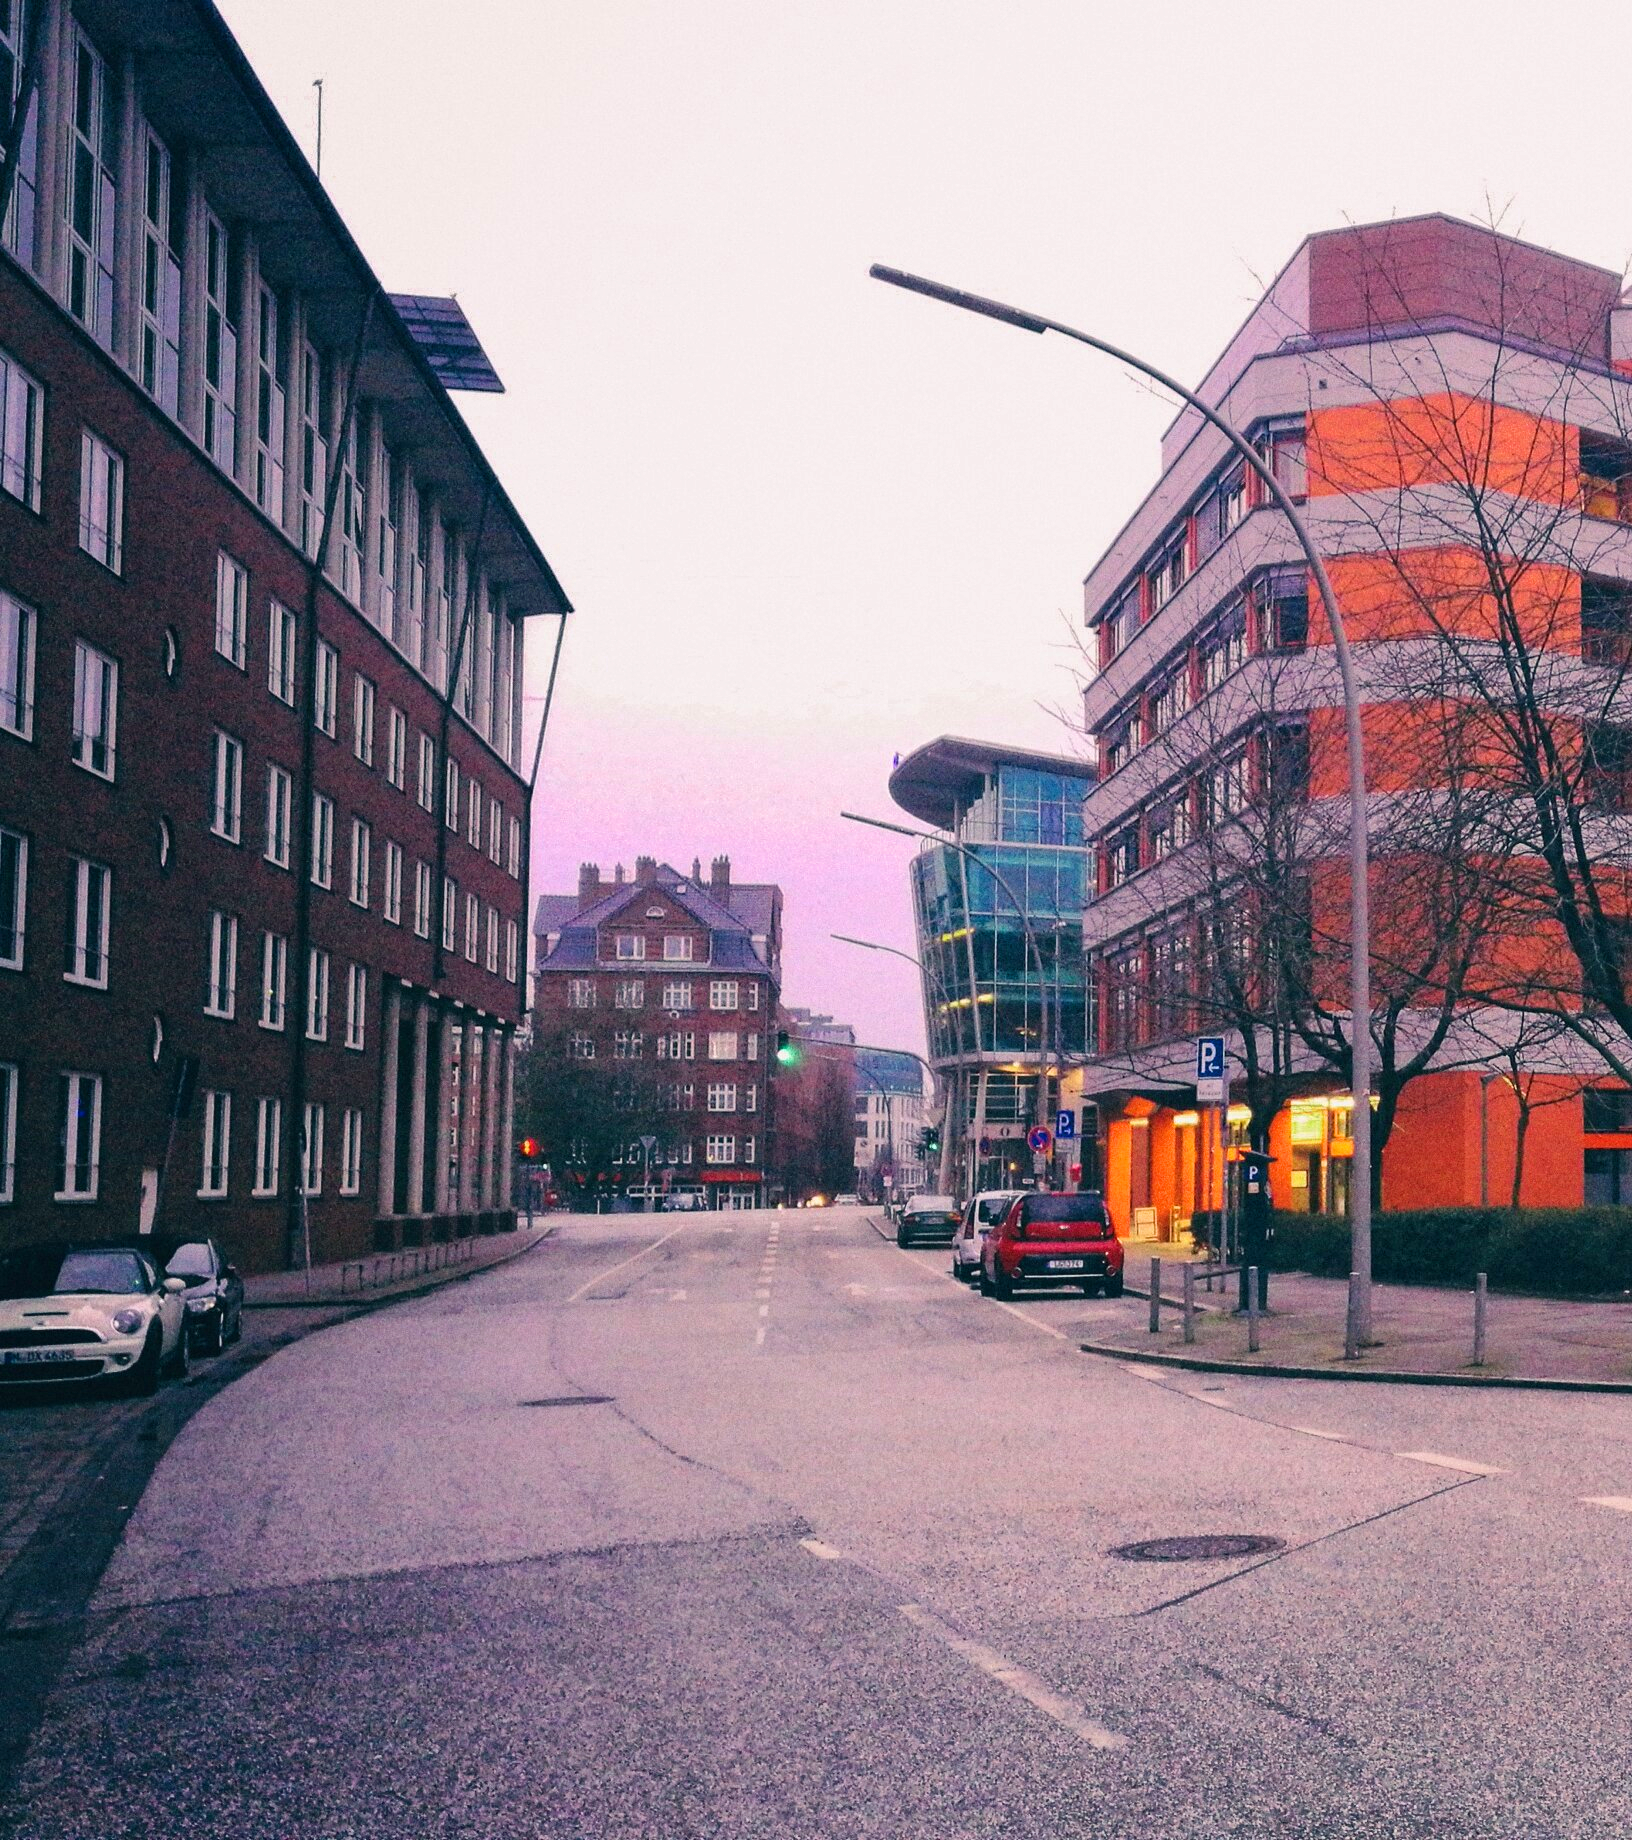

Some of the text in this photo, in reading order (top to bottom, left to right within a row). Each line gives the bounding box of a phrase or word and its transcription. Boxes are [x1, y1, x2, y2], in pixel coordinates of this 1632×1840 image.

[1201, 1042, 1217, 1074] P
[1059, 1113, 1070, 1135] P
[1249, 1165, 1258, 1180] P
